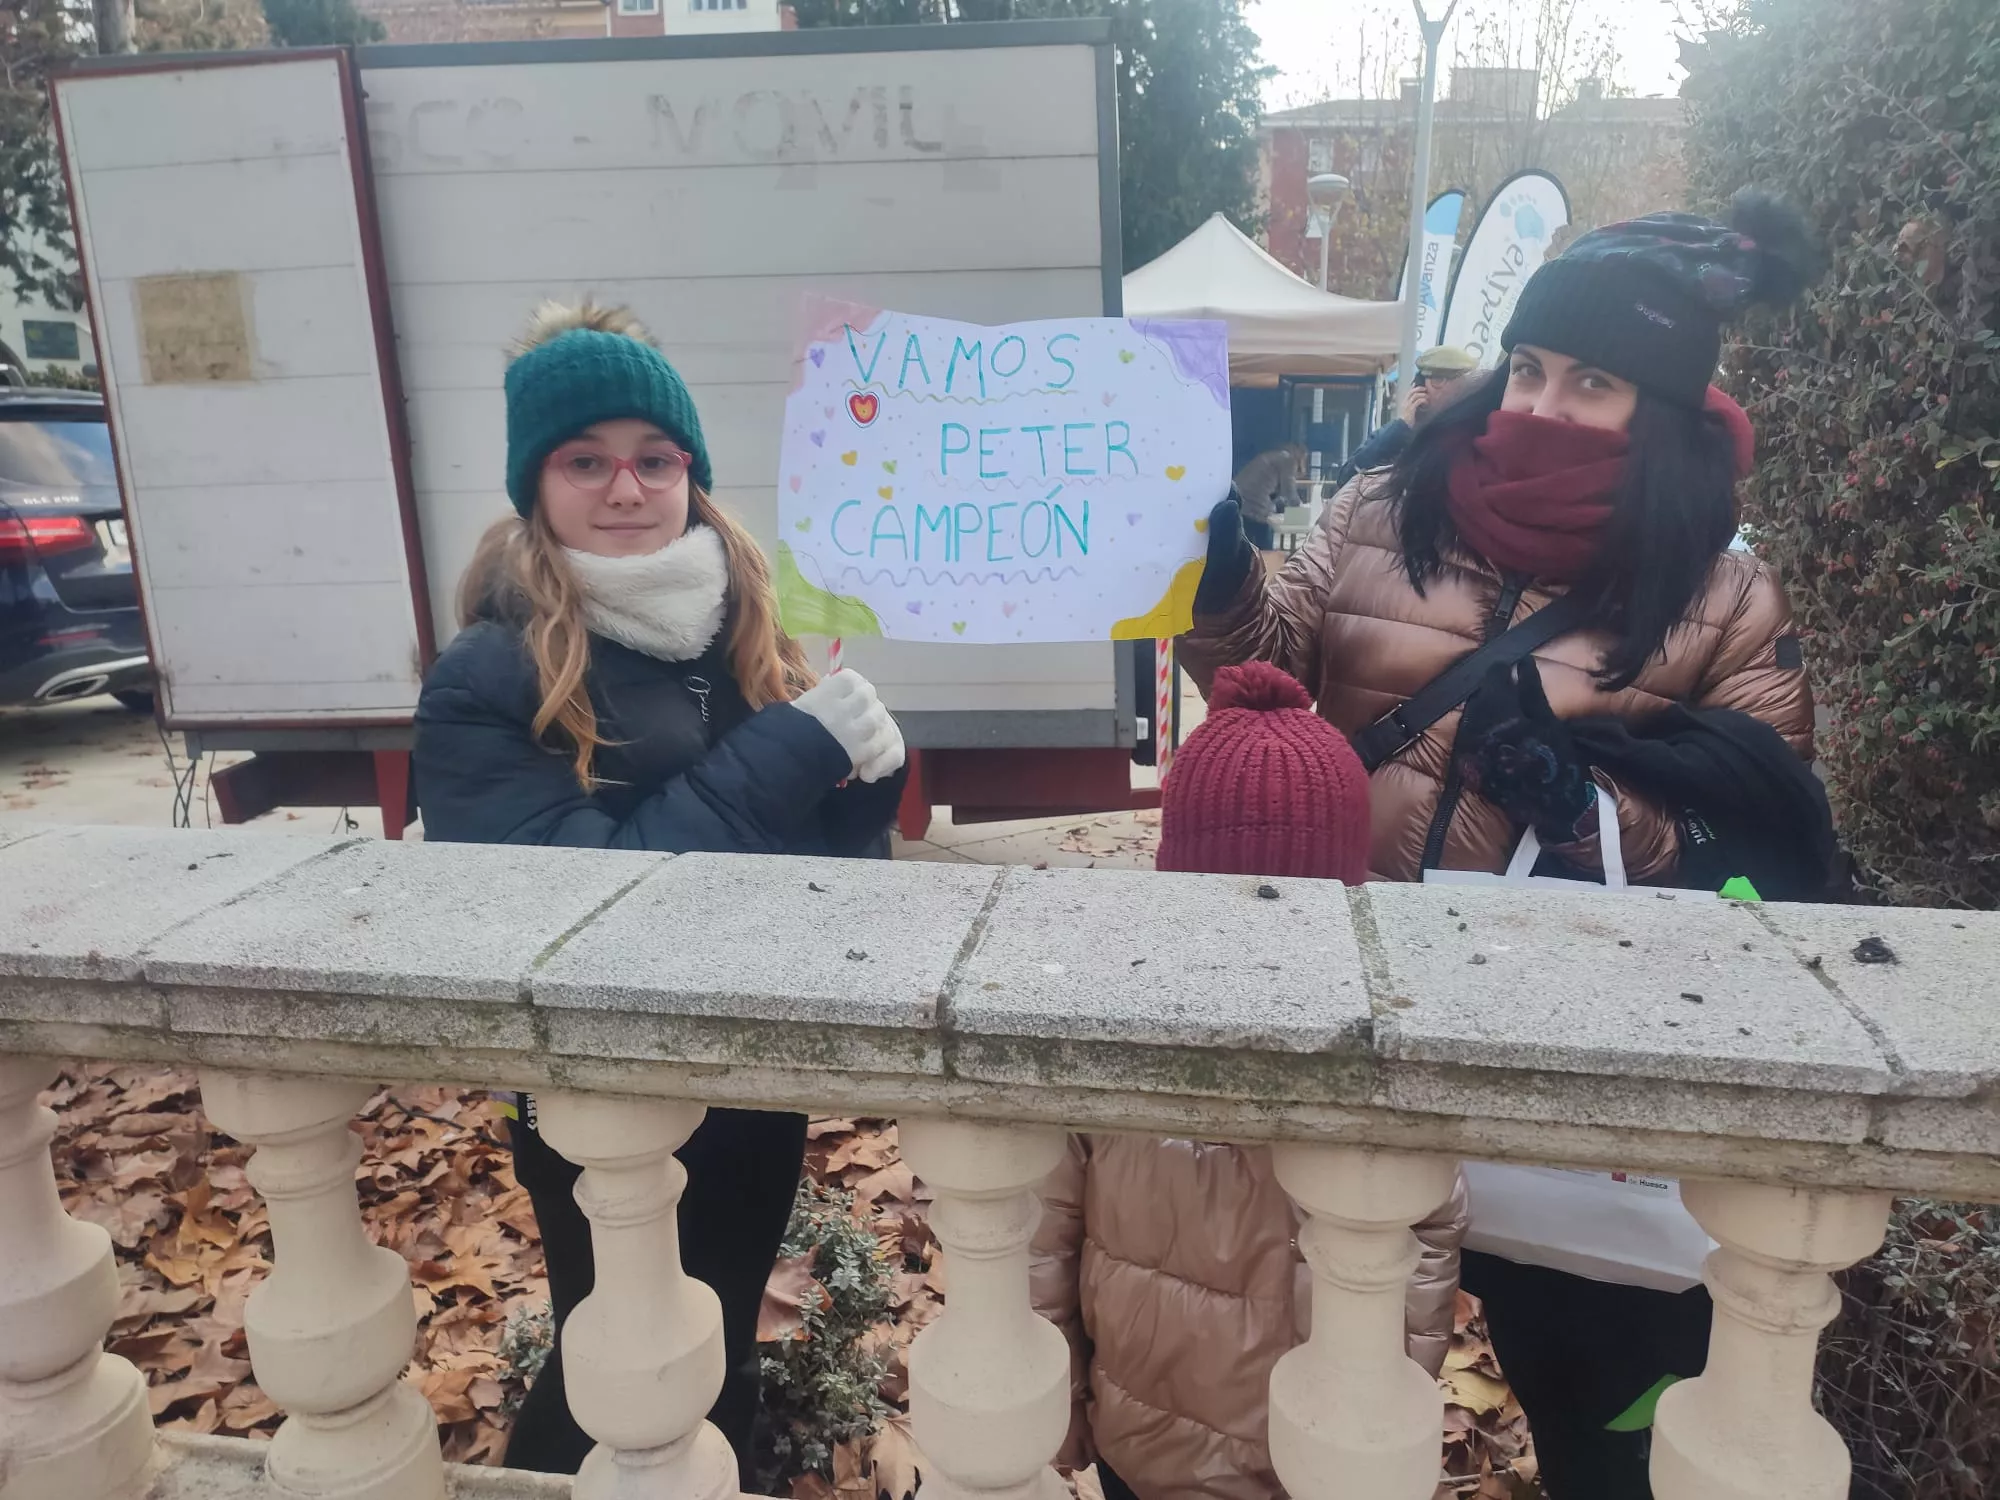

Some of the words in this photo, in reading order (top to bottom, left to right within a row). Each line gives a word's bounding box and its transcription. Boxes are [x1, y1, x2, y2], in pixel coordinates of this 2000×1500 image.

[843, 322, 1080, 398] VAMOS
[940, 421, 1139, 479] PETER
[830, 484, 1090, 562] CAMPEÓN
